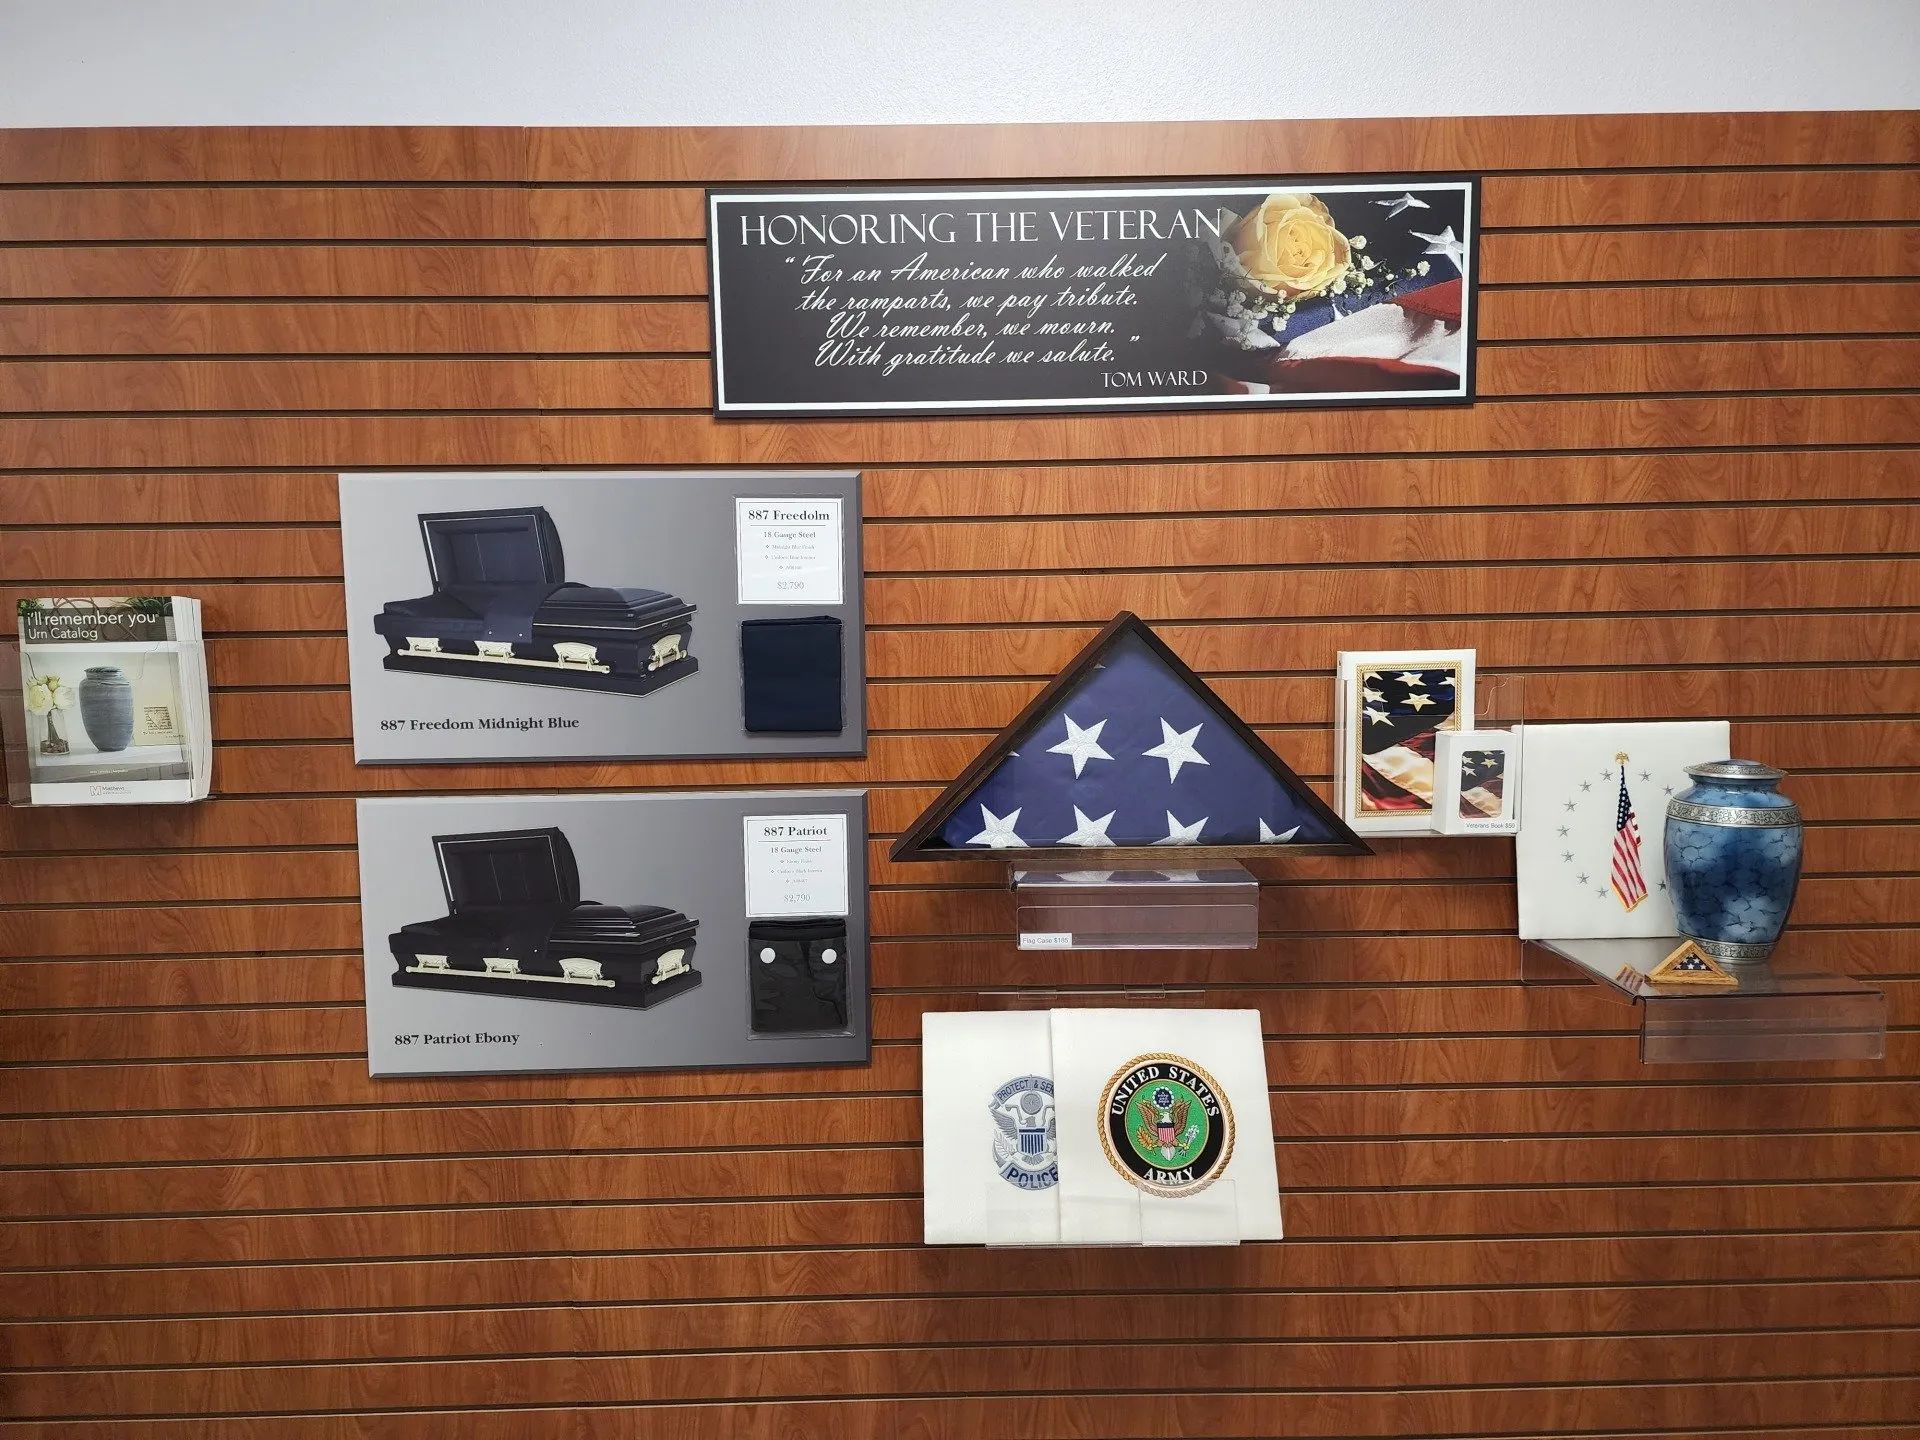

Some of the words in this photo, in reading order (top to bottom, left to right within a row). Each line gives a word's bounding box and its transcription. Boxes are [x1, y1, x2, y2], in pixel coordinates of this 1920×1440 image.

[739, 212, 957, 246] HONORING
[967, 211, 1039, 243] THE
[1049, 208, 1222, 242] VETERAN
[847, 267, 882, 282] an
[890, 252, 1009, 281] American
[1014, 254, 1065, 280] who
[1070, 252, 1168, 278] walked
[795, 286, 837, 311] the
[841, 288, 952, 318] ramparts,
[960, 294, 995, 309] we
[996, 293, 1048, 319] pay
[1050, 282, 1138, 307] tribute.
[826, 311, 871, 339] We
[873, 312, 988, 340] remember,
[996, 321, 1032, 336] we
[1034, 320, 1116, 336] mourn.
[814, 339, 886, 367] With
[882, 340, 996, 377] gratitude
[999, 350, 1035, 364] we
[1037, 338, 1116, 363] salute.
[1101, 371, 1143, 388] TOM
[1148, 370, 1208, 387] WARD
[748, 509, 769, 521] 887
[773, 509, 830, 521] Freedolm
[774, 531, 797, 540] Gauge
[776, 581, 805, 590] $2,790
[45, 609, 124, 626] remember
[28, 627, 48, 640] Urn
[50, 626, 99, 641] Catalog
[380, 719, 406, 731] 887
[410, 718, 475, 731] Freedom
[478, 716, 544, 732] Midnight
[547, 716, 580, 729] Blue
[764, 826, 784, 837] 887
[788, 825, 828, 837] Patriot
[771, 846, 779, 854] 18
[780, 846, 802, 854] Gauge
[784, 894, 811, 903] $2,790
[1022, 937, 1036, 945] Flag
[394, 1034, 420, 1046] 887
[423, 1033, 471, 1045] Patriot
[475, 1031, 521, 1046] Ebony
[997, 1079, 1029, 1101] PROTECT
[1033, 1079, 1039, 1089] &
[1112, 1066, 1160, 1116] UNITED
[1168, 1066, 1220, 1117] STATES
[1006, 1165, 1059, 1189] POLICE
[1143, 1166, 1195, 1184] ARMY
